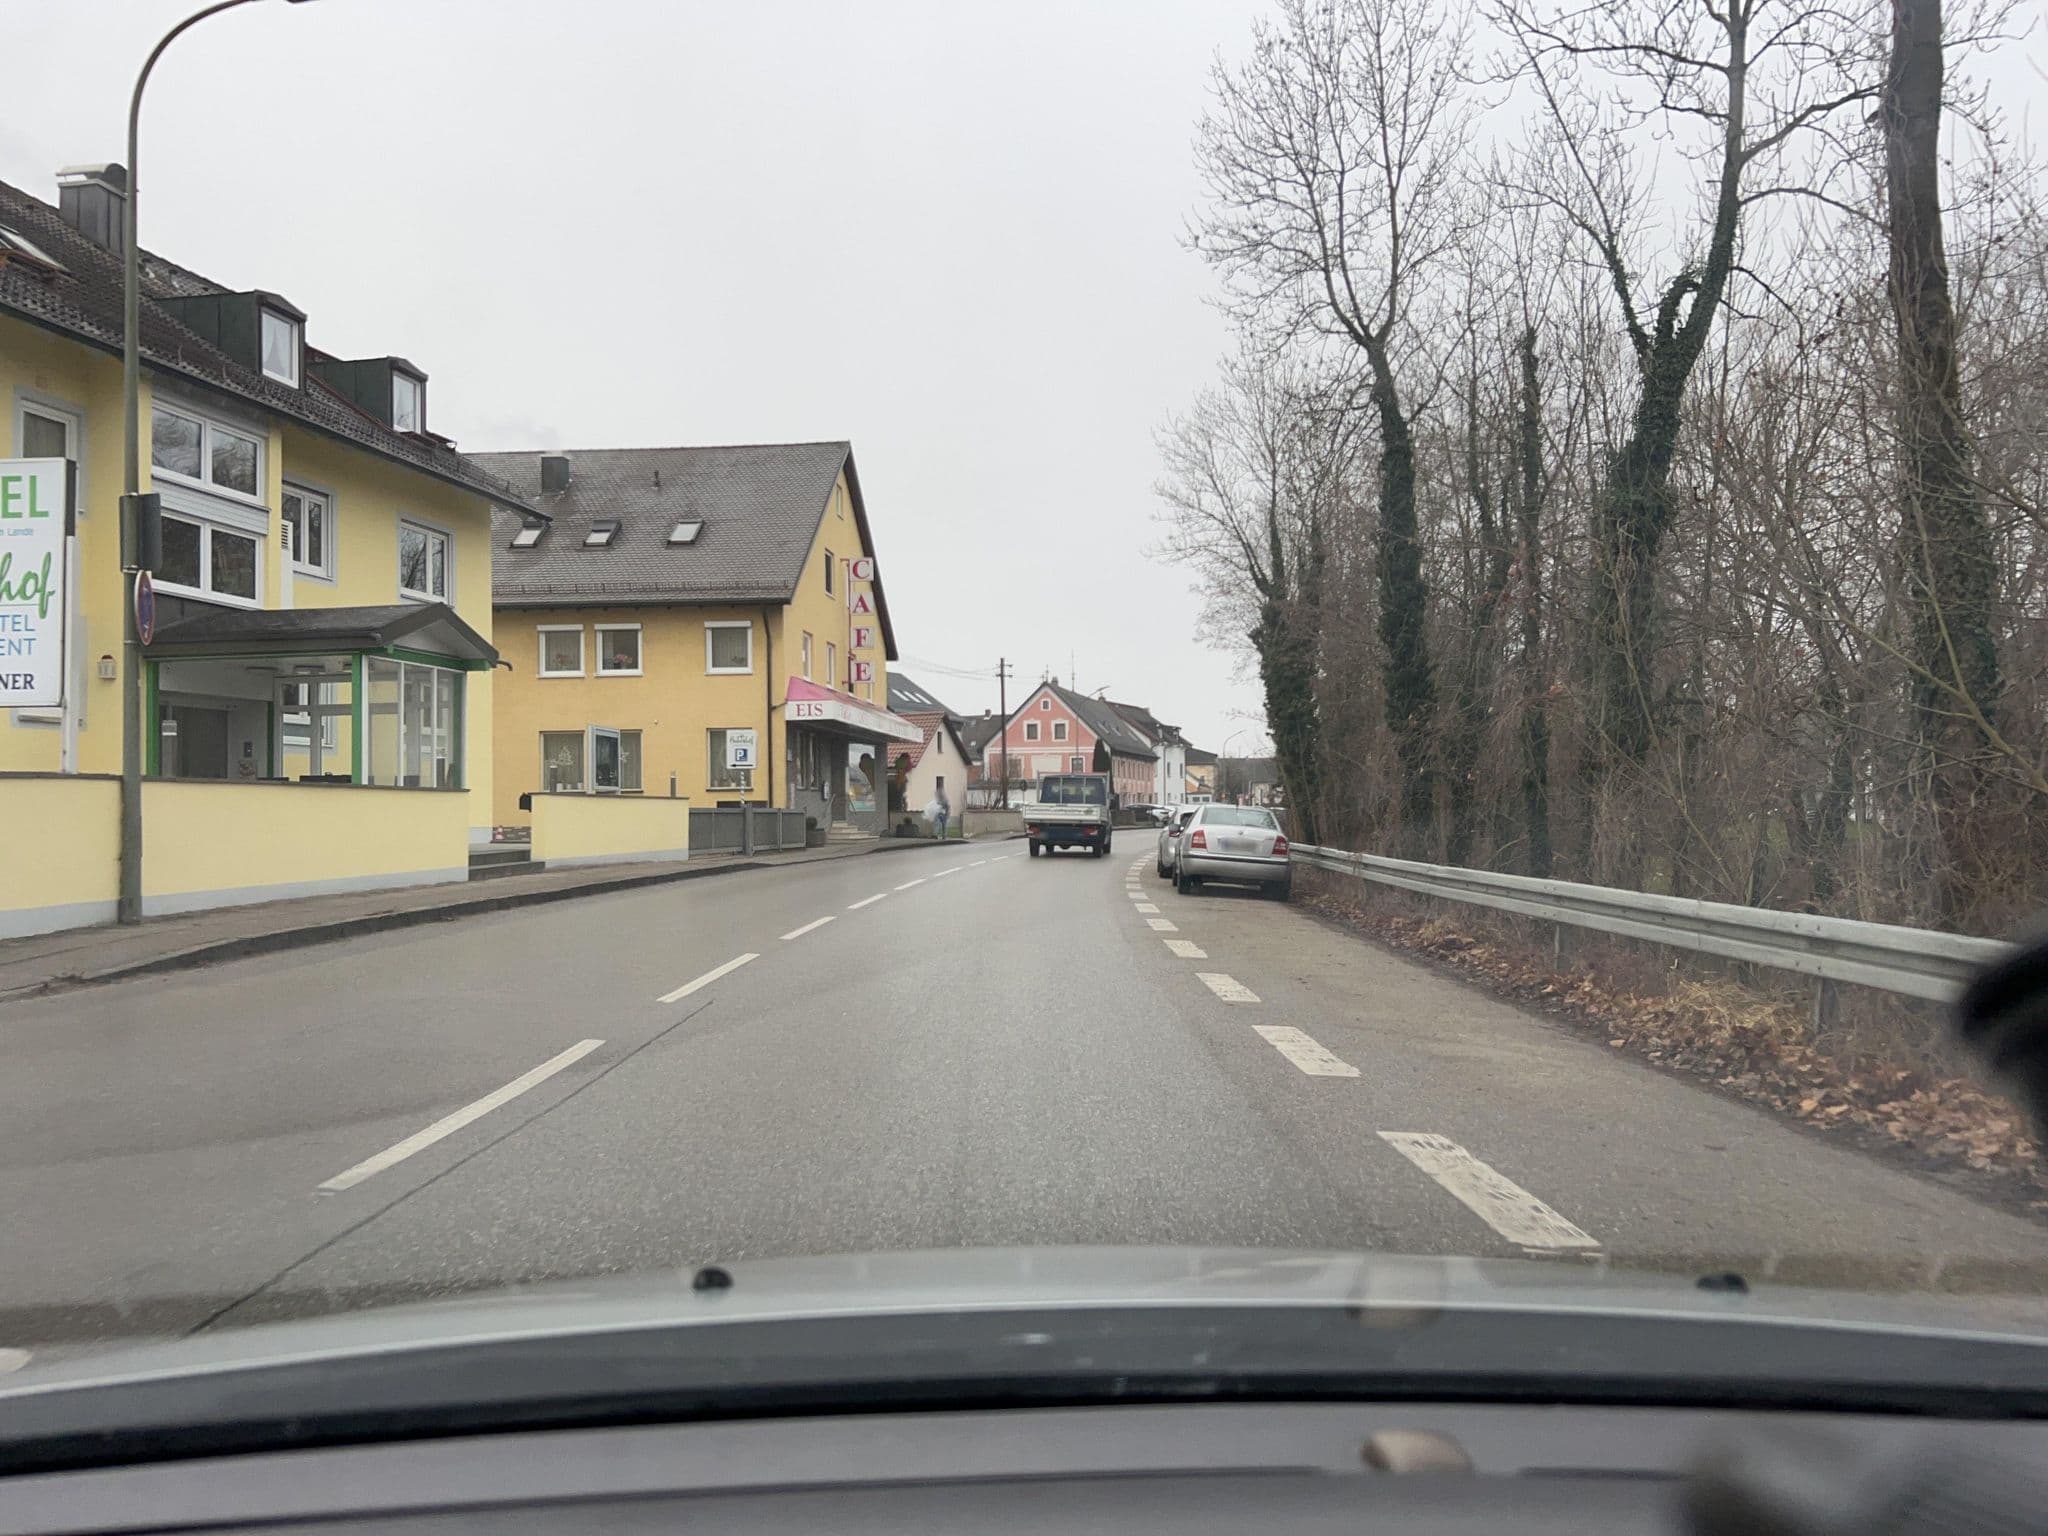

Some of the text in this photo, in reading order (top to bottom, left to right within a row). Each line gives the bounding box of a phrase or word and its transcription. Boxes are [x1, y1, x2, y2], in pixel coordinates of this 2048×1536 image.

[1, 475, 49, 519] EL
[0, 614, 36, 632] TEL
[852, 560, 872, 682] CAFE
[796, 704, 824, 717] EIS
[736, 749, 745, 761] P
